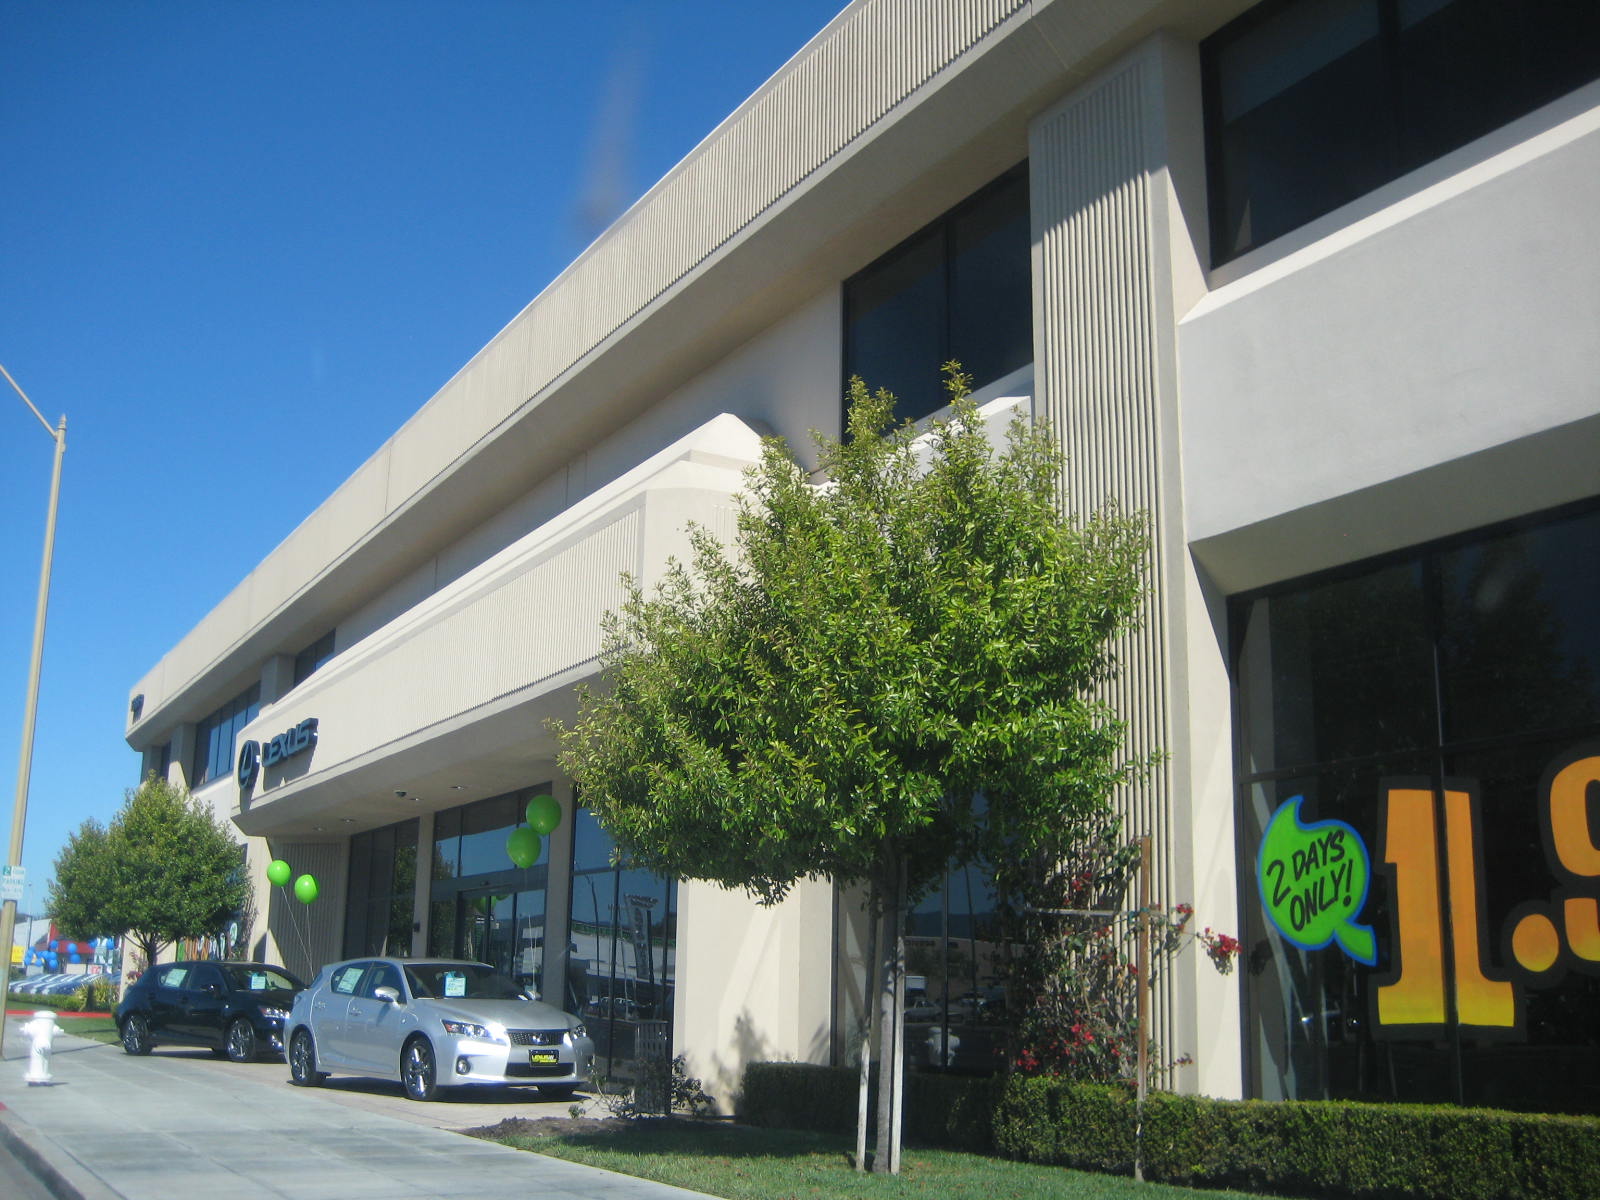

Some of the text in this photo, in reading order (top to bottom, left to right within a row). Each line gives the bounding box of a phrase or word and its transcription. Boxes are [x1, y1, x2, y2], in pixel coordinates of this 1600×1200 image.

[261, 717, 319, 768] LEXUS
[1266, 829, 1345, 908] 2 DAYS
[1289, 858, 1353, 932] ONLY!
